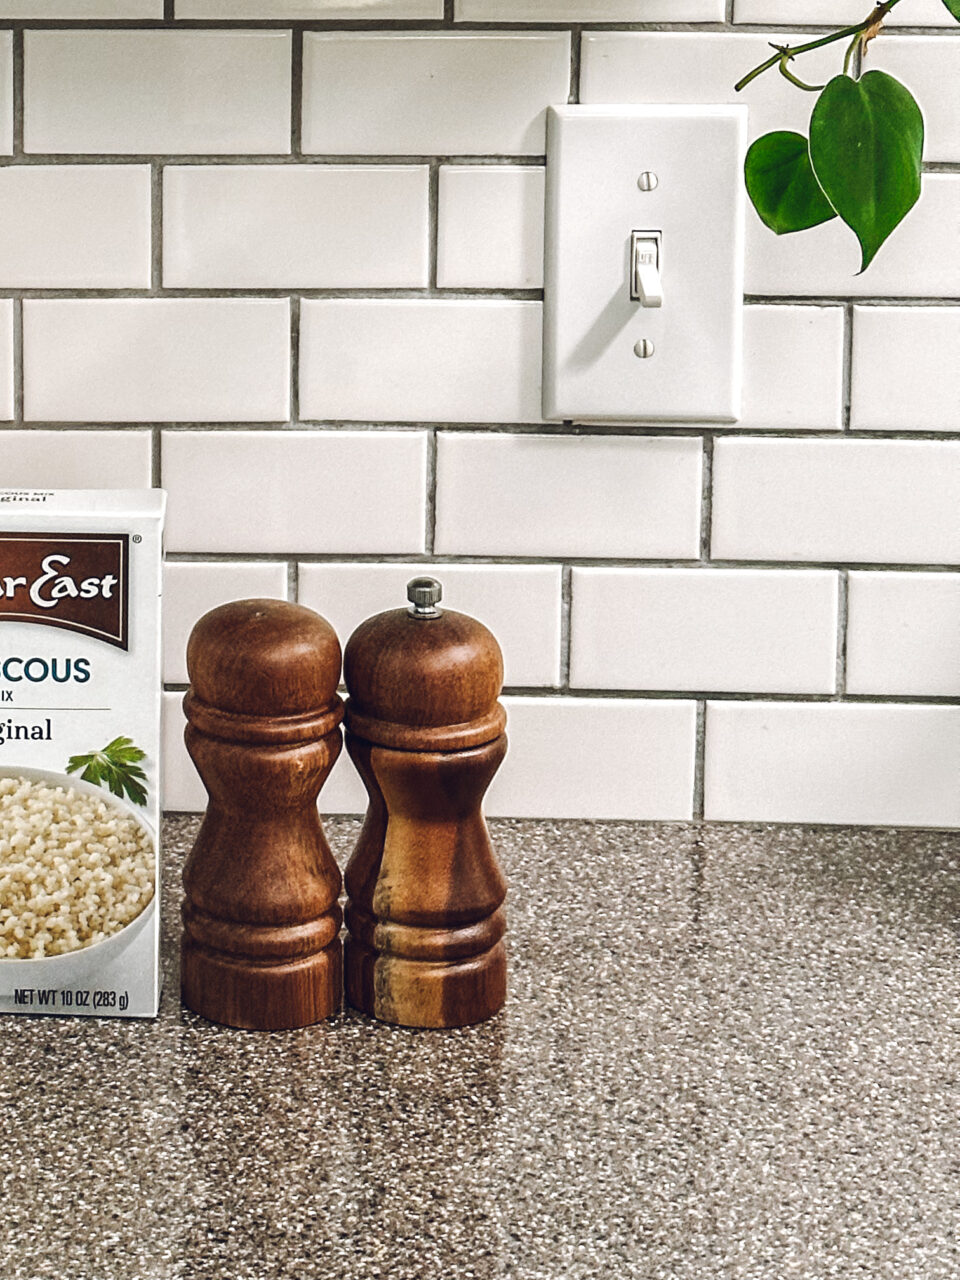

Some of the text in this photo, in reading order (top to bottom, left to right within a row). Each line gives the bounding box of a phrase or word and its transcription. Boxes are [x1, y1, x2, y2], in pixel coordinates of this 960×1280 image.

[29, 554, 118, 608] East
[14, 989, 129, 1011] NET WT 10 OZ (283 g)
